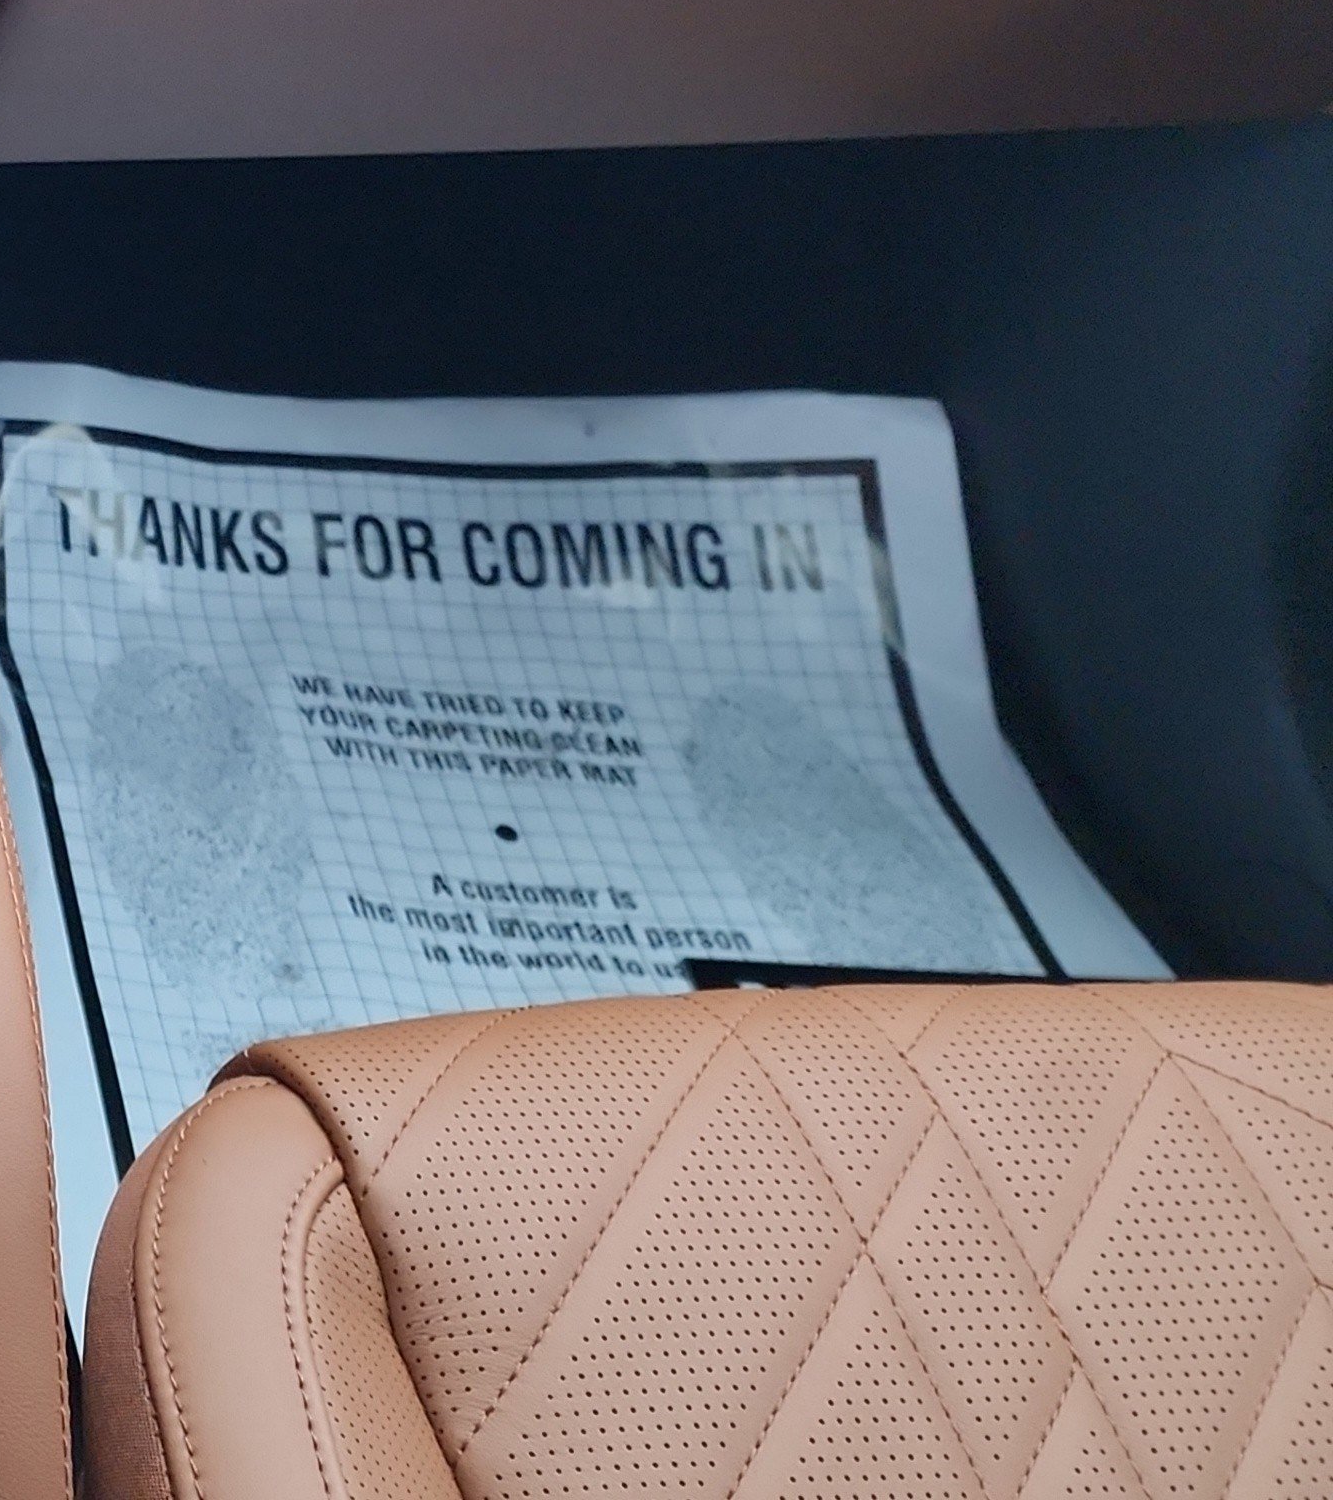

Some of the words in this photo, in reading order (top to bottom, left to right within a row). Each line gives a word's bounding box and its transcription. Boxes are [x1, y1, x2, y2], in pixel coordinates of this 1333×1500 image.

[47, 485, 290, 577] THANKS
[311, 510, 443, 583] FOR
[462, 521, 731, 591] COMING
[753, 522, 824, 592] IN
[291, 673, 333, 697] WE
[343, 681, 414, 710] HAVE
[422, 690, 506, 717] TRIED
[512, 696, 550, 722] TO
[557, 700, 625, 726] KEEP
[299, 705, 377, 734] YOUR
[385, 717, 543, 751] CARPETING
[550, 731, 642, 757] CLEAN
[324, 736, 399, 767] WITH
[406, 748, 473, 773] THIS
[480, 754, 573, 781] PAPER
[579, 761, 638, 787] MAT
[432, 874, 453, 898] A
[461, 881, 599, 909] customer
[611, 886, 637, 911] is
[348, 894, 395, 923] the
[404, 907, 477, 935] most
[488, 911, 639, 947] important
[644, 925, 753, 953] person
[420, 938, 450, 964] in
[458, 944, 507, 968] the
[518, 950, 605, 974] world
[612, 955, 645, 978] to
